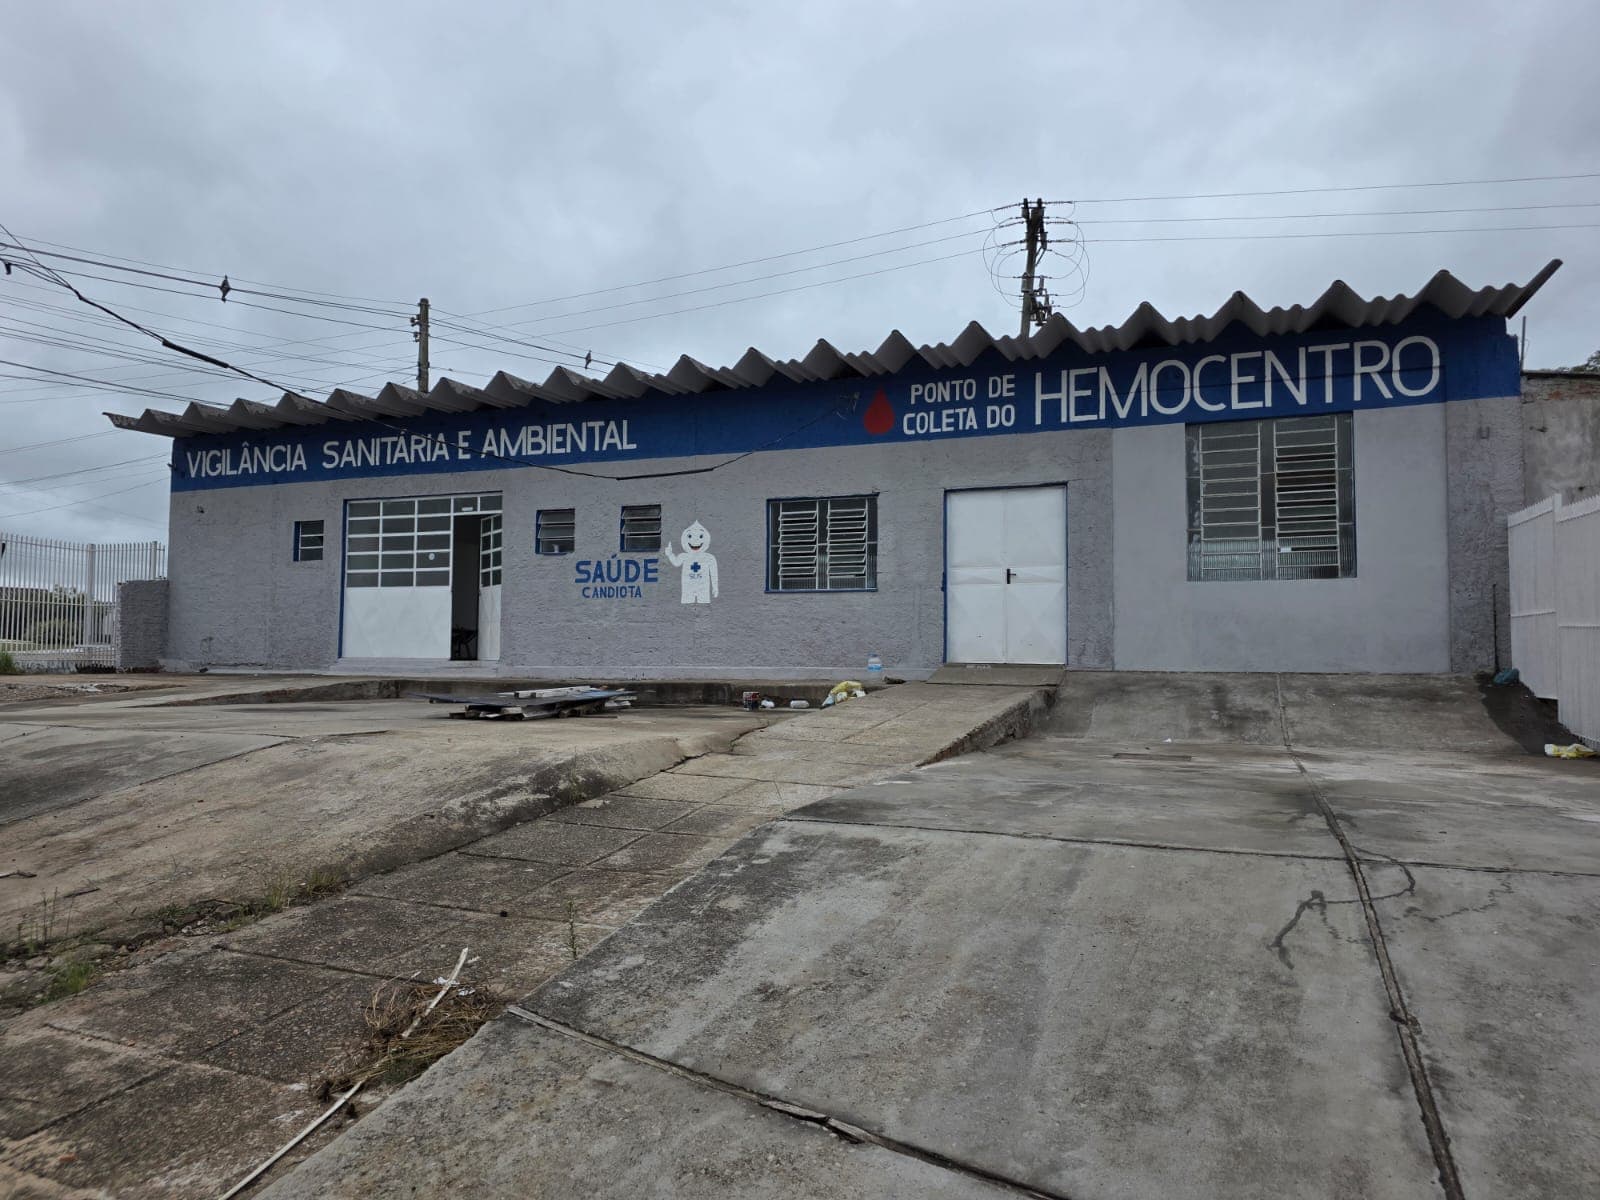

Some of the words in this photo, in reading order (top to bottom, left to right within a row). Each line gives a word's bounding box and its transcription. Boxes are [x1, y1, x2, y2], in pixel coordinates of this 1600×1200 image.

[910, 378, 977, 405] PONTO
[988, 374, 1016, 399] DE
[1034, 335, 1441, 425] HEMOCENTRO
[902, 407, 978, 435] COLETA
[986, 404, 1016, 429] DO
[186, 441, 308, 478] VIGILÂNCIA
[321, 428, 450, 469] SANITÁRIA
[457, 430, 472, 460] E
[480, 419, 637, 459] AMBIENTAL
[574, 553, 660, 584] SAÚDE
[582, 585, 642, 599] CANDIOTA
